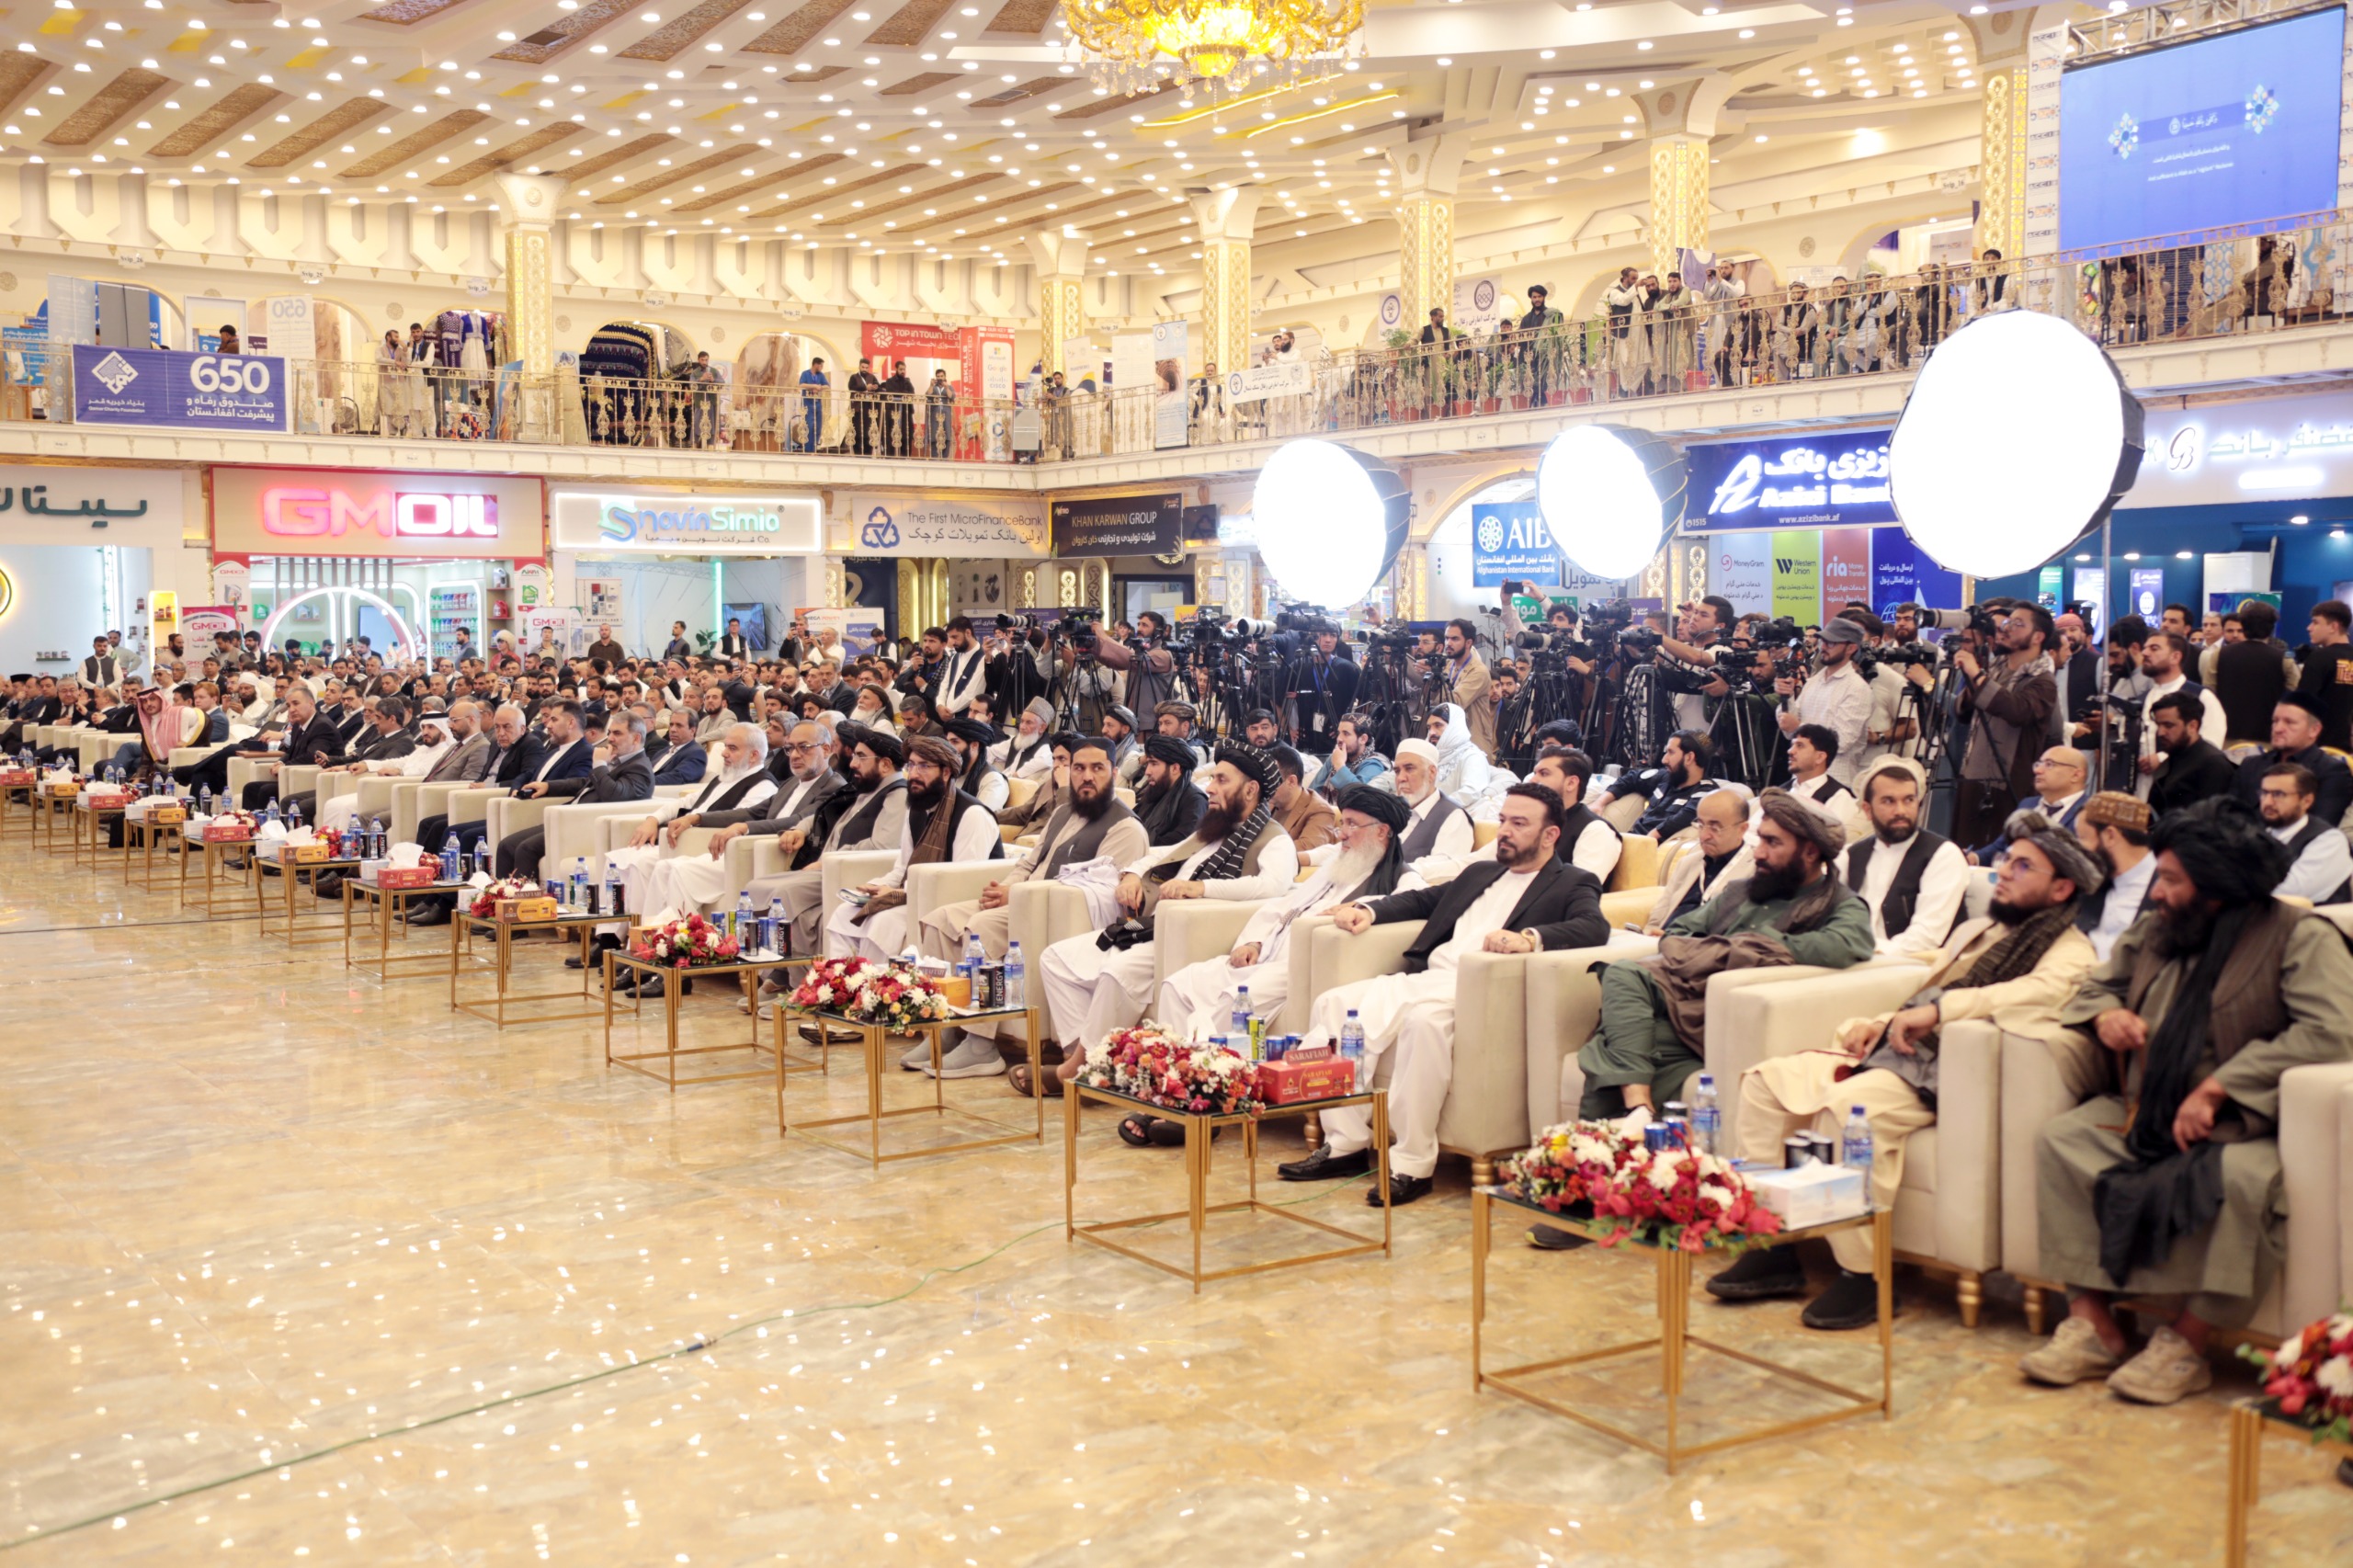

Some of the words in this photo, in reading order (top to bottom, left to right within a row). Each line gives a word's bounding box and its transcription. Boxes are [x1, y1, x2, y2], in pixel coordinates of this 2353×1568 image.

[894, 329, 911, 337] TOP
[190, 356, 270, 394] 650
[219, 396, 274, 409] صندوق
[187, 406, 235, 418] افغانستان
[236, 409, 274, 423] پیشرفت
[1827, 446, 1890, 480] زیزی
[907, 512, 926, 524] The
[929, 513, 948, 524] First
[950, 513, 1042, 526] MicroFinanceBank
[1072, 515, 1094, 528] KHAN
[1094, 513, 1128, 527] KARWAN
[1129, 511, 1157, 525] GROUP
[908, 528, 945, 544] کوچک
[992, 528, 1017, 542] بانک
[1020, 529, 1043, 545] اولین
[1141, 530, 1156, 544] شرکت
[1476, 566, 1507, 575] Afghanistan
[1507, 565, 1541, 574] International
[1541, 565, 1555, 574] Bank
[1733, 560, 1765, 569] MoneyGram
[1793, 559, 1817, 567] Western
[1826, 555, 1848, 577] ria
[1793, 567, 1811, 575] Union
[1289, 1049, 1329, 1062] SARAFIAH
